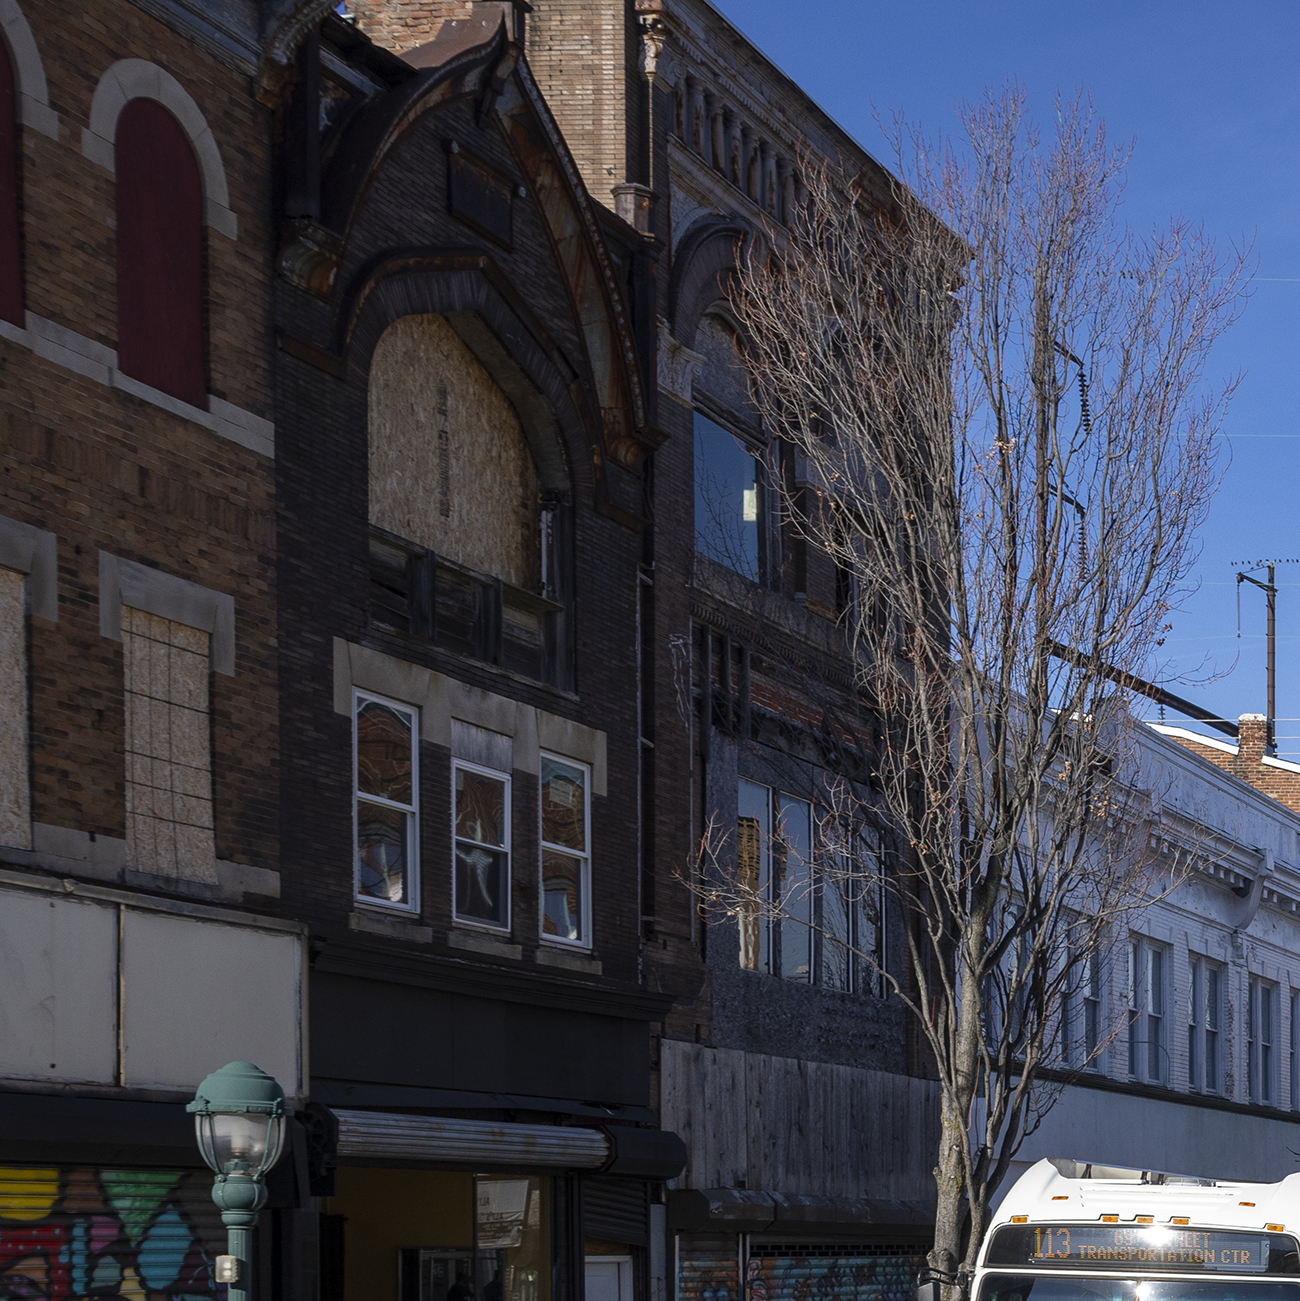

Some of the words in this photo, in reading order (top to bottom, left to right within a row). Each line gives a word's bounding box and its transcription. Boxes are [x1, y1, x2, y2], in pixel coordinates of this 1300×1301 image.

[1033, 1227, 1071, 1259] 113
[1078, 1244, 1215, 1263] TRANSPORTATION
[1220, 1249, 1251, 1264] CTR
